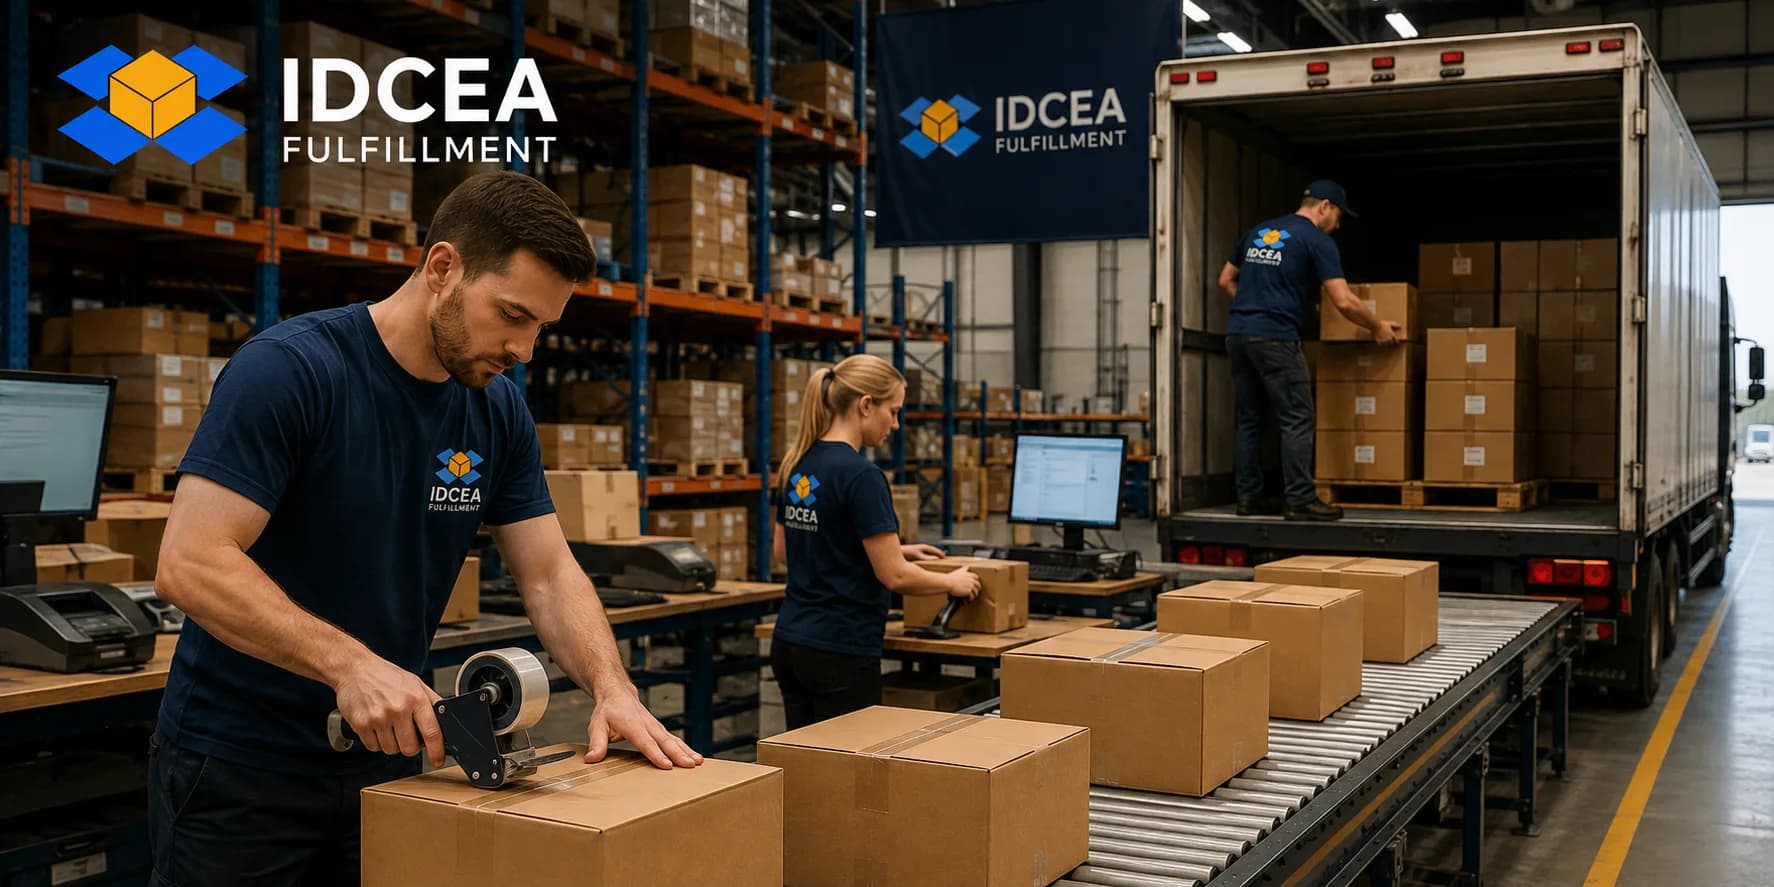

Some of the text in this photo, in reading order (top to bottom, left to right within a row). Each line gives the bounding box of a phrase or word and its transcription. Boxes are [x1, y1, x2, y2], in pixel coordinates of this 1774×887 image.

[995, 87, 1127, 133] IDCEA
[995, 129, 1127, 154] FULFILLMENT
[1246, 248, 1282, 261] IDCEA
[430, 486, 481, 503] IDCEA
[785, 505, 818, 524] IDCEA
